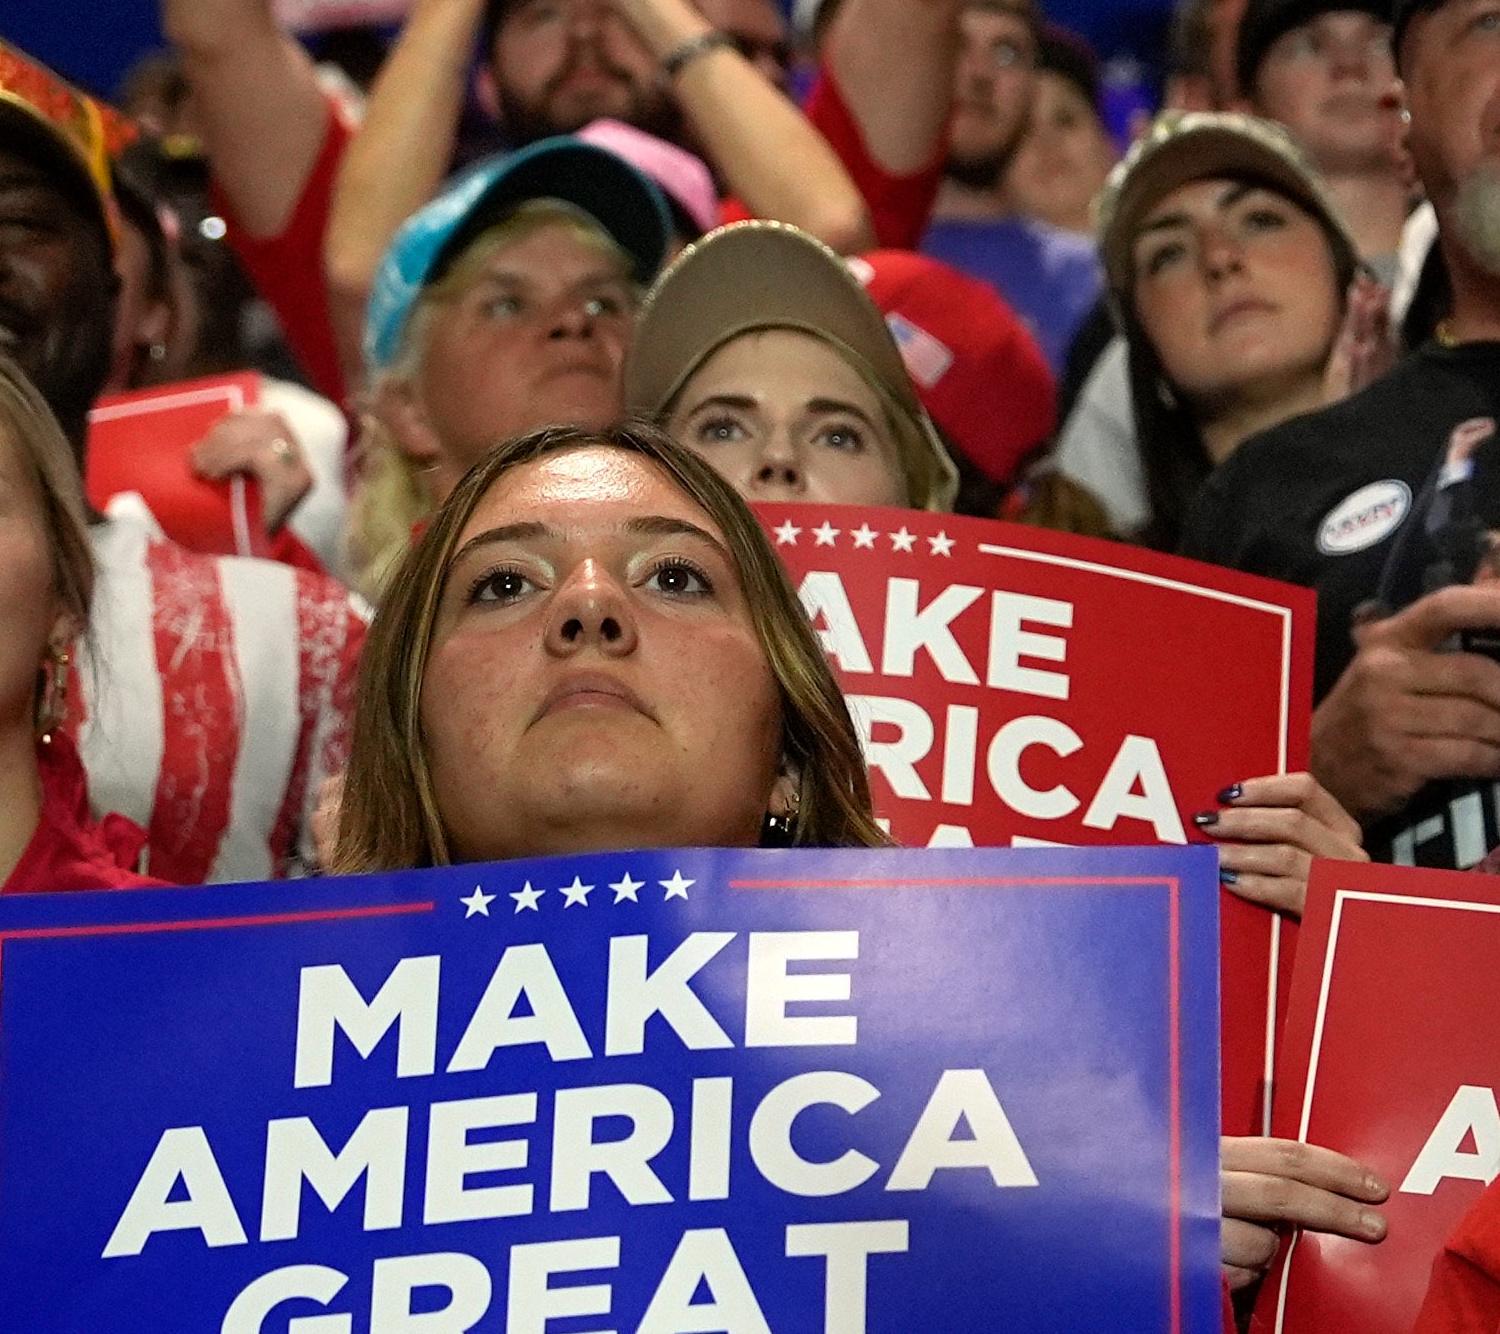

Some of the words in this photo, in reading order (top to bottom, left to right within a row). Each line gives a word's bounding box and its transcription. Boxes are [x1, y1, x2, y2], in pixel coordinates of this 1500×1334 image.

[797, 572, 1075, 701] AKE
[855, 696, 1187, 844] RICA
[293, 929, 860, 1089] MAKE
[101, 1067, 1040, 1259] AMERICA
